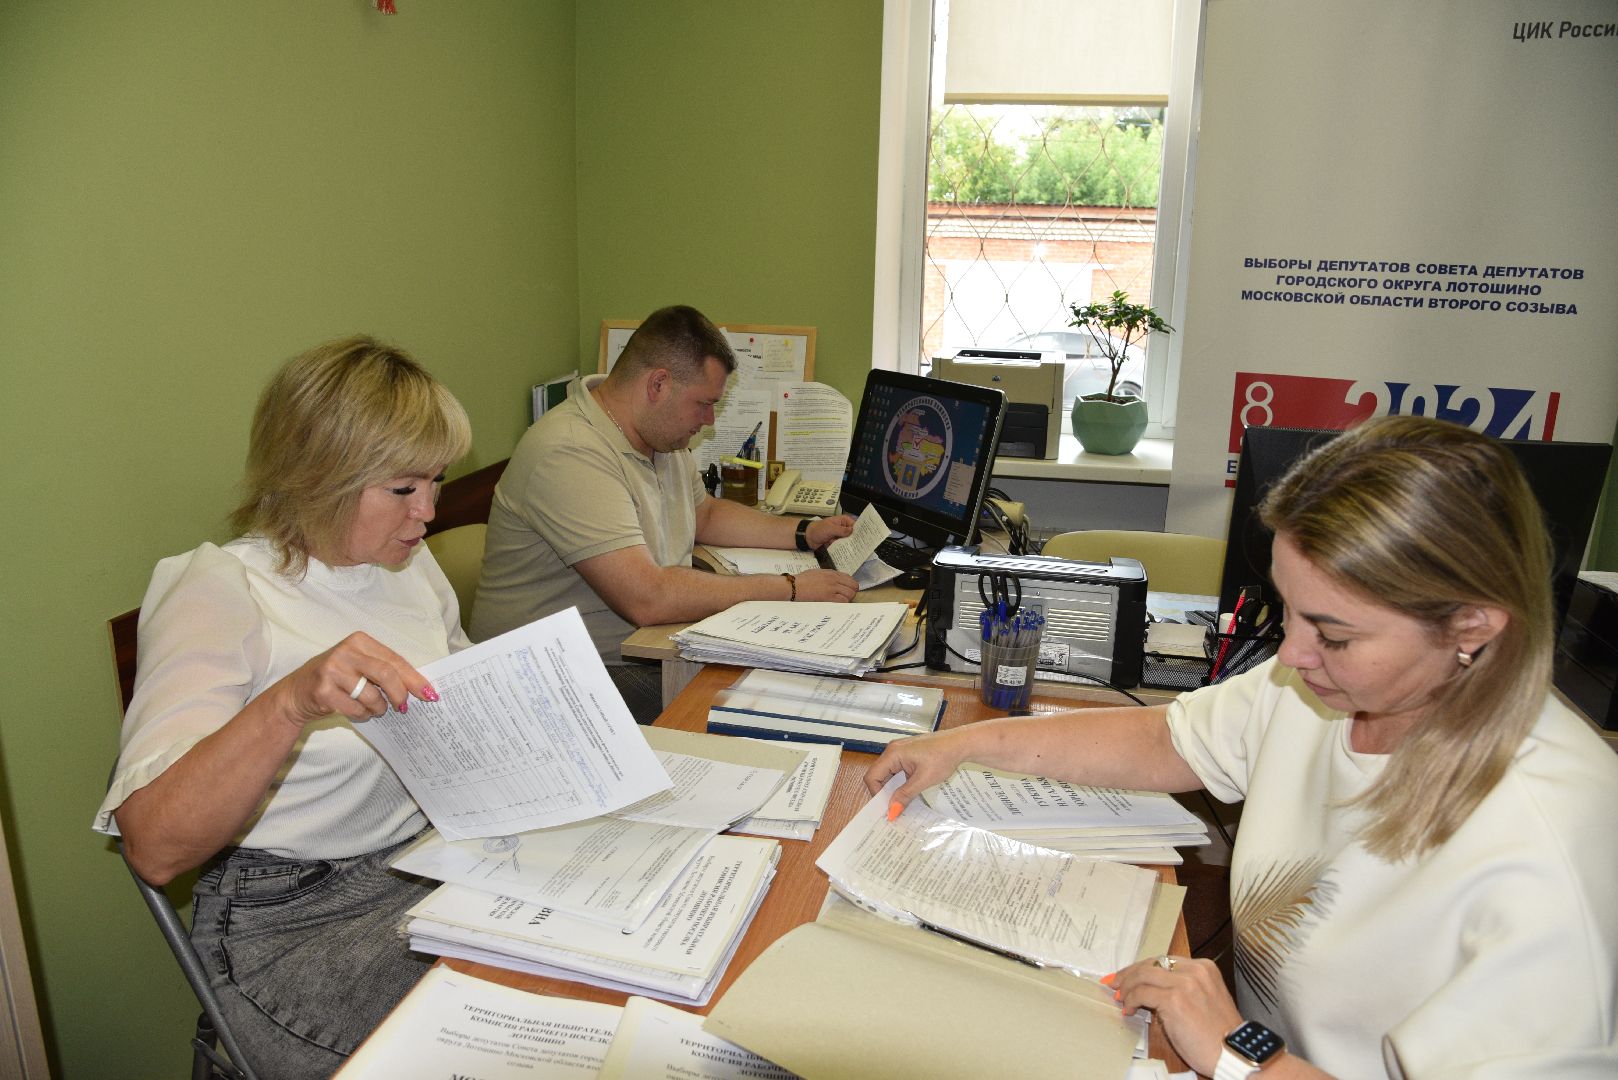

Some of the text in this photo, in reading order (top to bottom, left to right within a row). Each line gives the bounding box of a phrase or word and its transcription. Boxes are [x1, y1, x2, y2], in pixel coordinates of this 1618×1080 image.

[1512, 21, 1618, 43] ЦИК Росси
[1244, 258, 1584, 280] ВЫБОРЫ ДЕПУТАТОВ СОВЕТА ДЕПУТАТОВ
[1276, 275, 1542, 296] ГОРОДСКОГО ОКРУГА ЛОТОШИНО
[1241, 290, 1578, 314] МОСКОВСКОЙ ОБЛАСТИ ВТОРОГО СОЗЫВА
[1240, 381, 1274, 427] 8
[464, 1004, 615, 1038] ТЕРРИТОРИАЛЬНАЯ ИЗБИРАТЕЛЬ
[510, 1033, 566, 1045] ЛОТОШИНО
[568, 1033, 610, 1045] ПОСЕЛК
[680, 1038, 768, 1061] ТЕРРИТОРИАЛЬН
